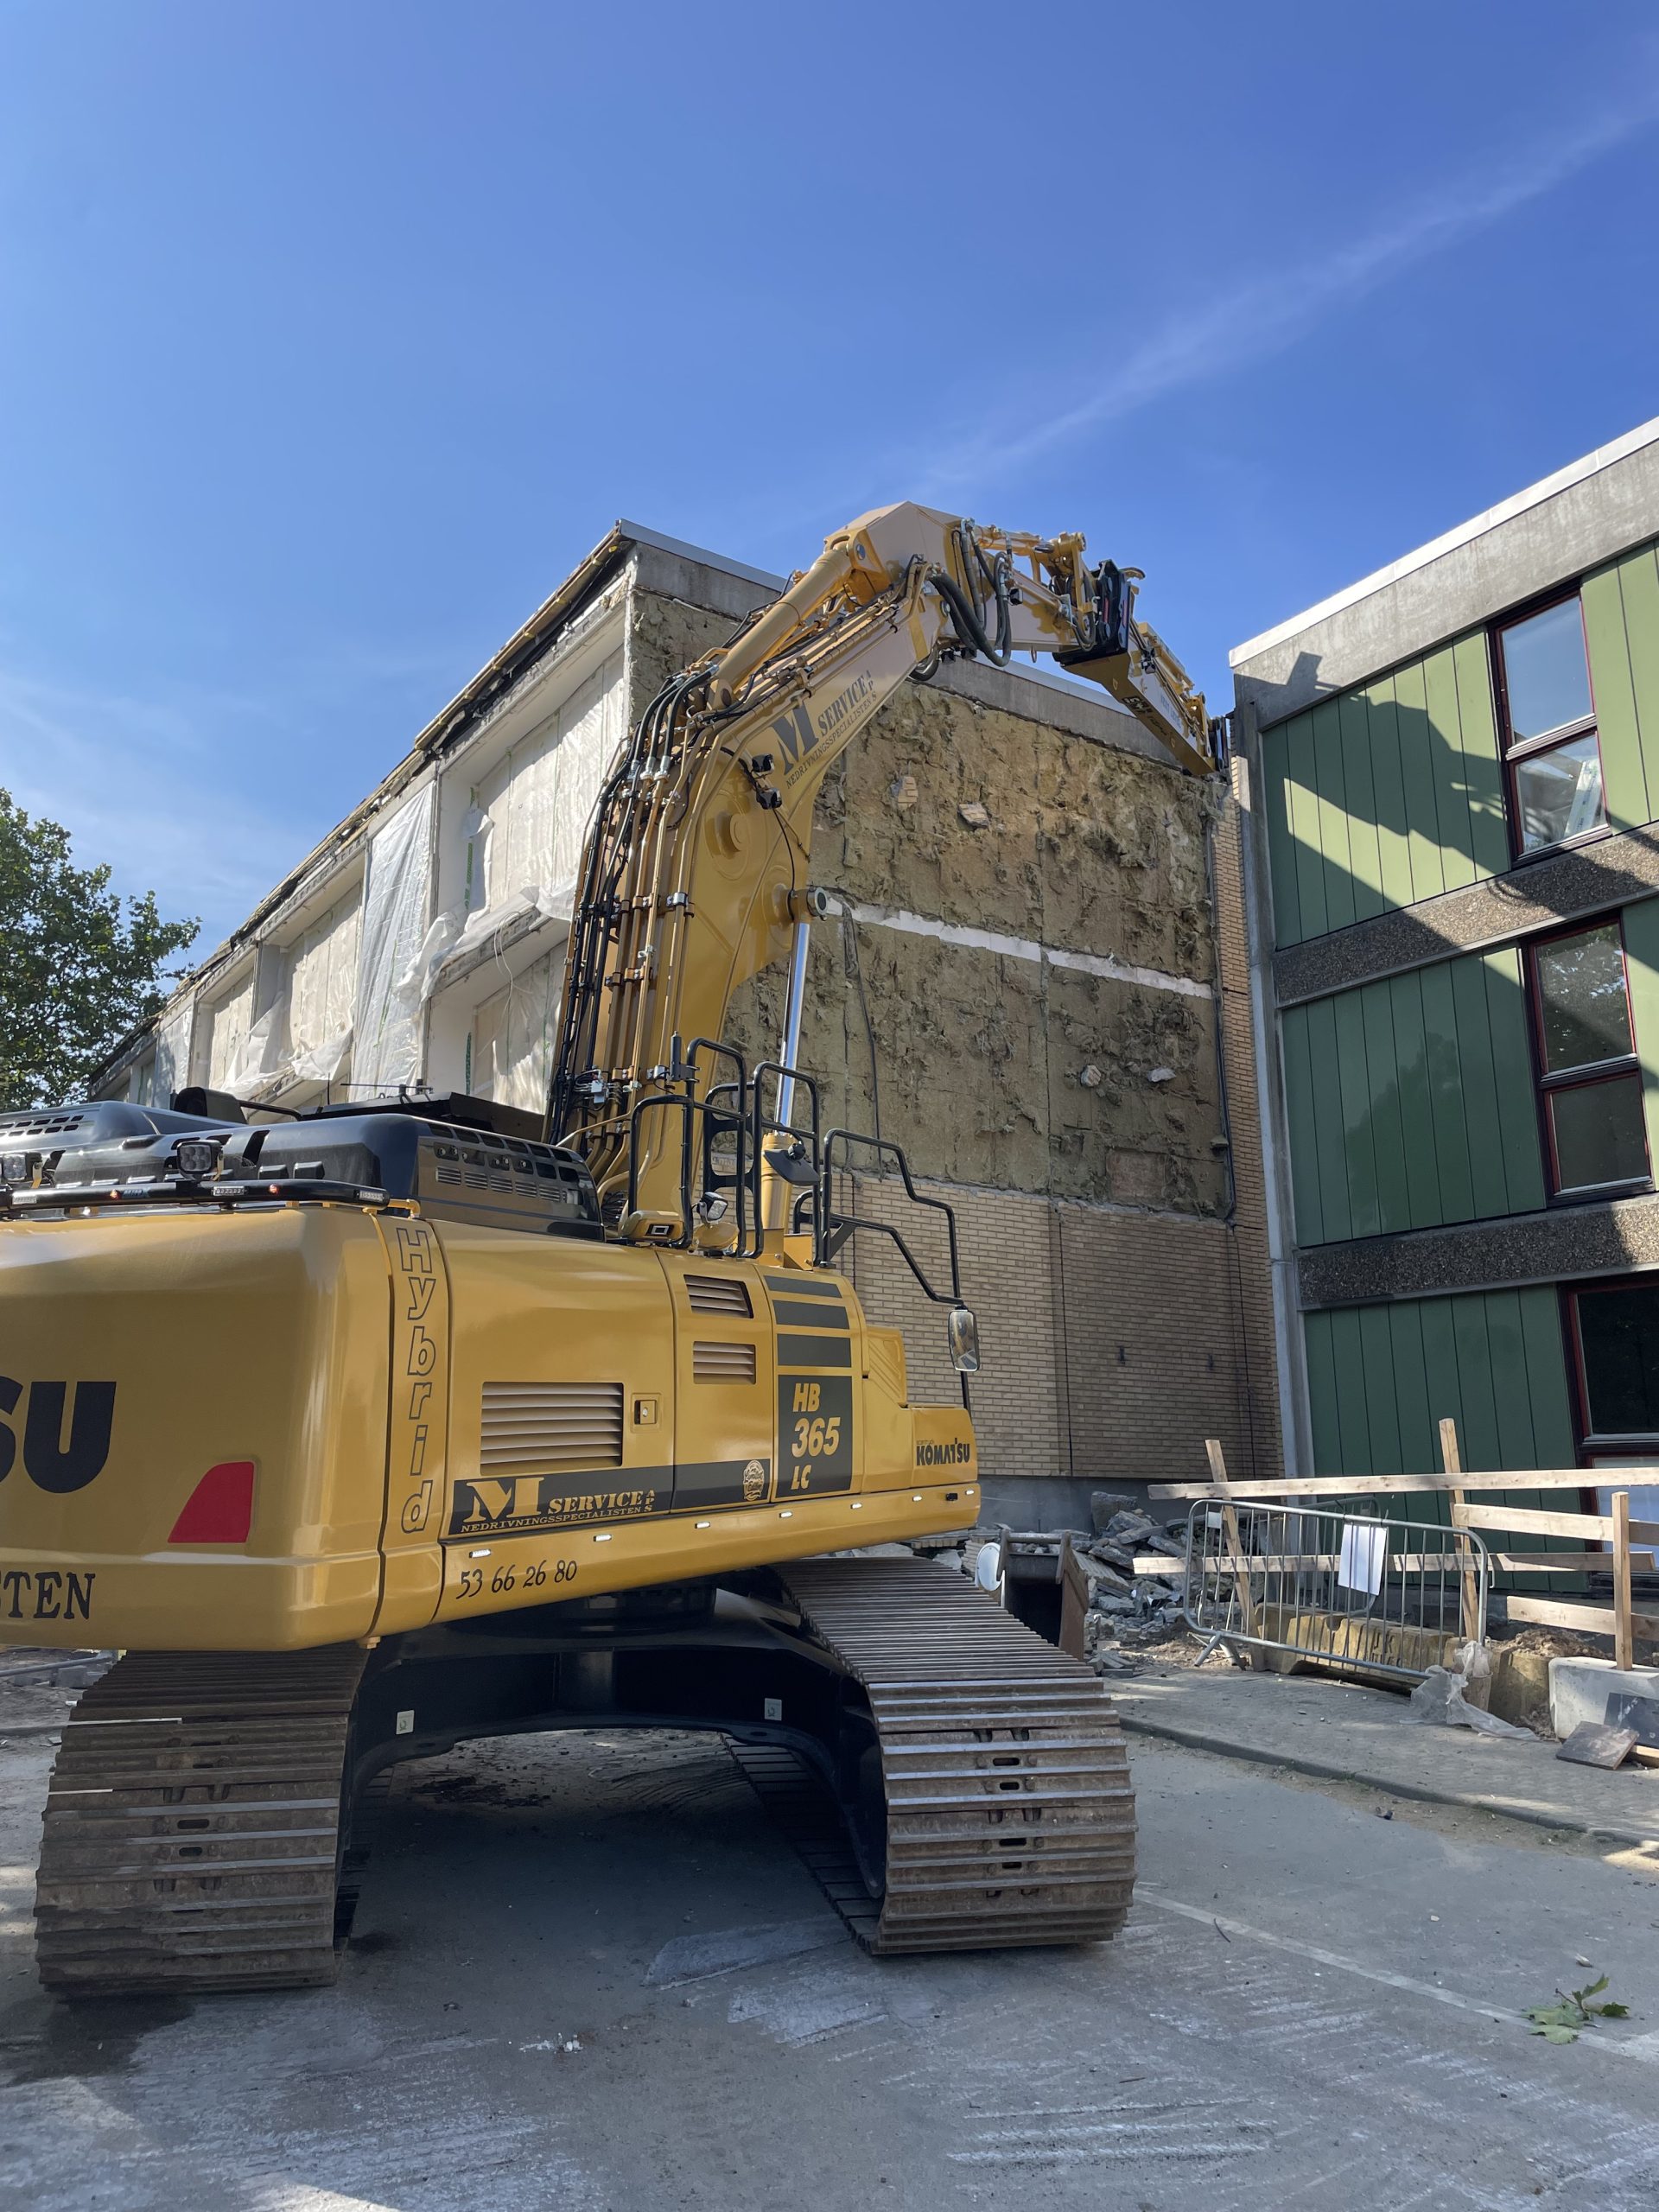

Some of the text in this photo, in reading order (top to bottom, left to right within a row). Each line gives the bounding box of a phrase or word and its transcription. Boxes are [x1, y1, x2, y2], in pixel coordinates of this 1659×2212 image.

[769, 699, 819, 776] M
[817, 673, 868, 737] SERVICE
[785, 699, 872, 790] NEDRIVNINGSSPECIALISTEN
[396, 1227, 436, 1534] Hybrid
[792, 1382, 821, 1413] HB
[791, 1416, 841, 1458] 365
[916, 1437, 969, 1466] KOMATSU
[790, 1465, 812, 1491] LC
[461, 1506, 641, 1533] NEDRIVNINGSSPECIALISTEN
[462, 1477, 544, 1522] M
[547, 1491, 644, 1515] SERVICE
[0, 1571, 96, 1620] TEN
[456, 1560, 577, 1599] 53 66 26 80
